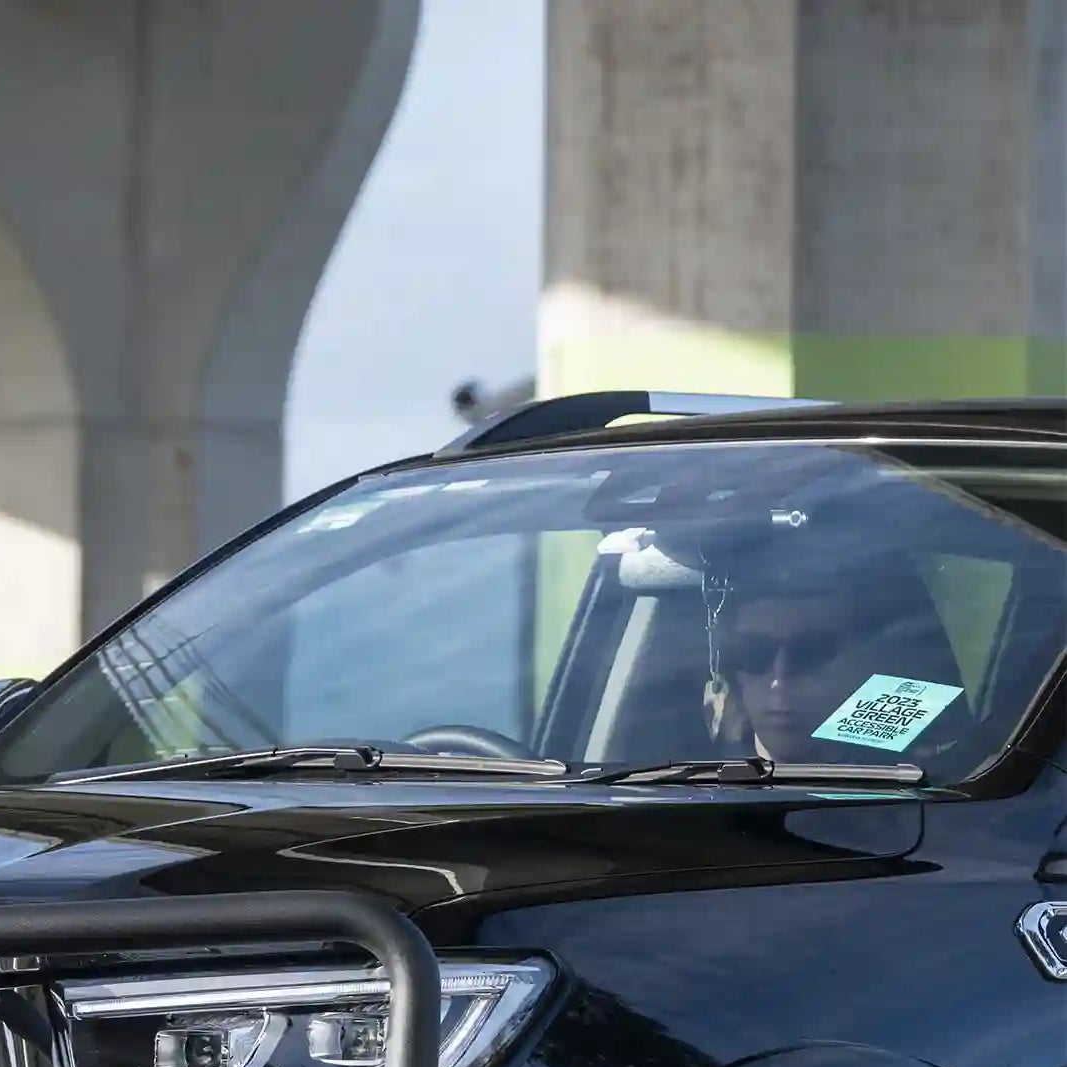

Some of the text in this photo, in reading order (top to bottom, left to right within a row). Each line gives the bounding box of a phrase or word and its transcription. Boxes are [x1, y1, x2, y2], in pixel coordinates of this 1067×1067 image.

[876, 694, 922, 708] 2023
[856, 700, 927, 719] VILLAGE
[851, 710, 913, 726] GREEN
[838, 718, 909, 735] ACCESSIBLE
